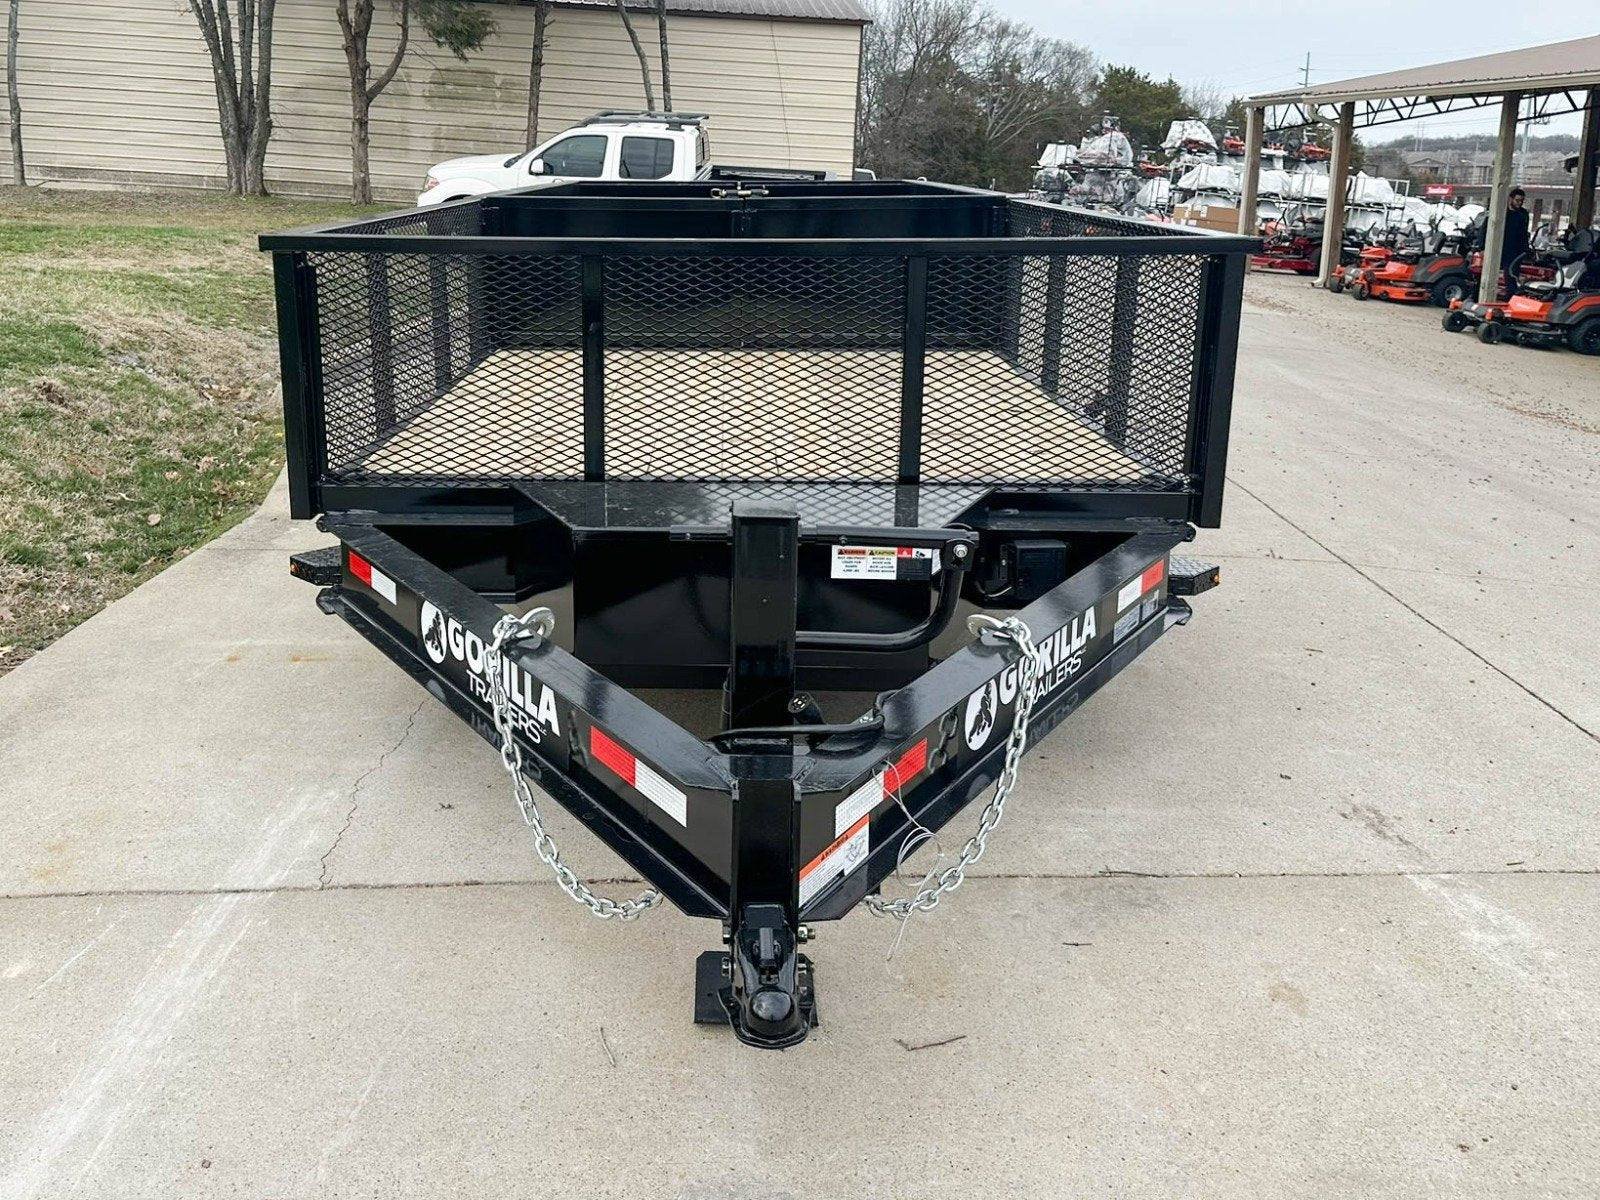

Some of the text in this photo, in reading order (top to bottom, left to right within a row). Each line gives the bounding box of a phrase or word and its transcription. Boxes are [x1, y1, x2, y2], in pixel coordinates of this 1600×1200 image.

[447, 617, 561, 737] GOILLA
[466, 669, 541, 744] TRAERS
[1030, 653, 1082, 706] AILERS
